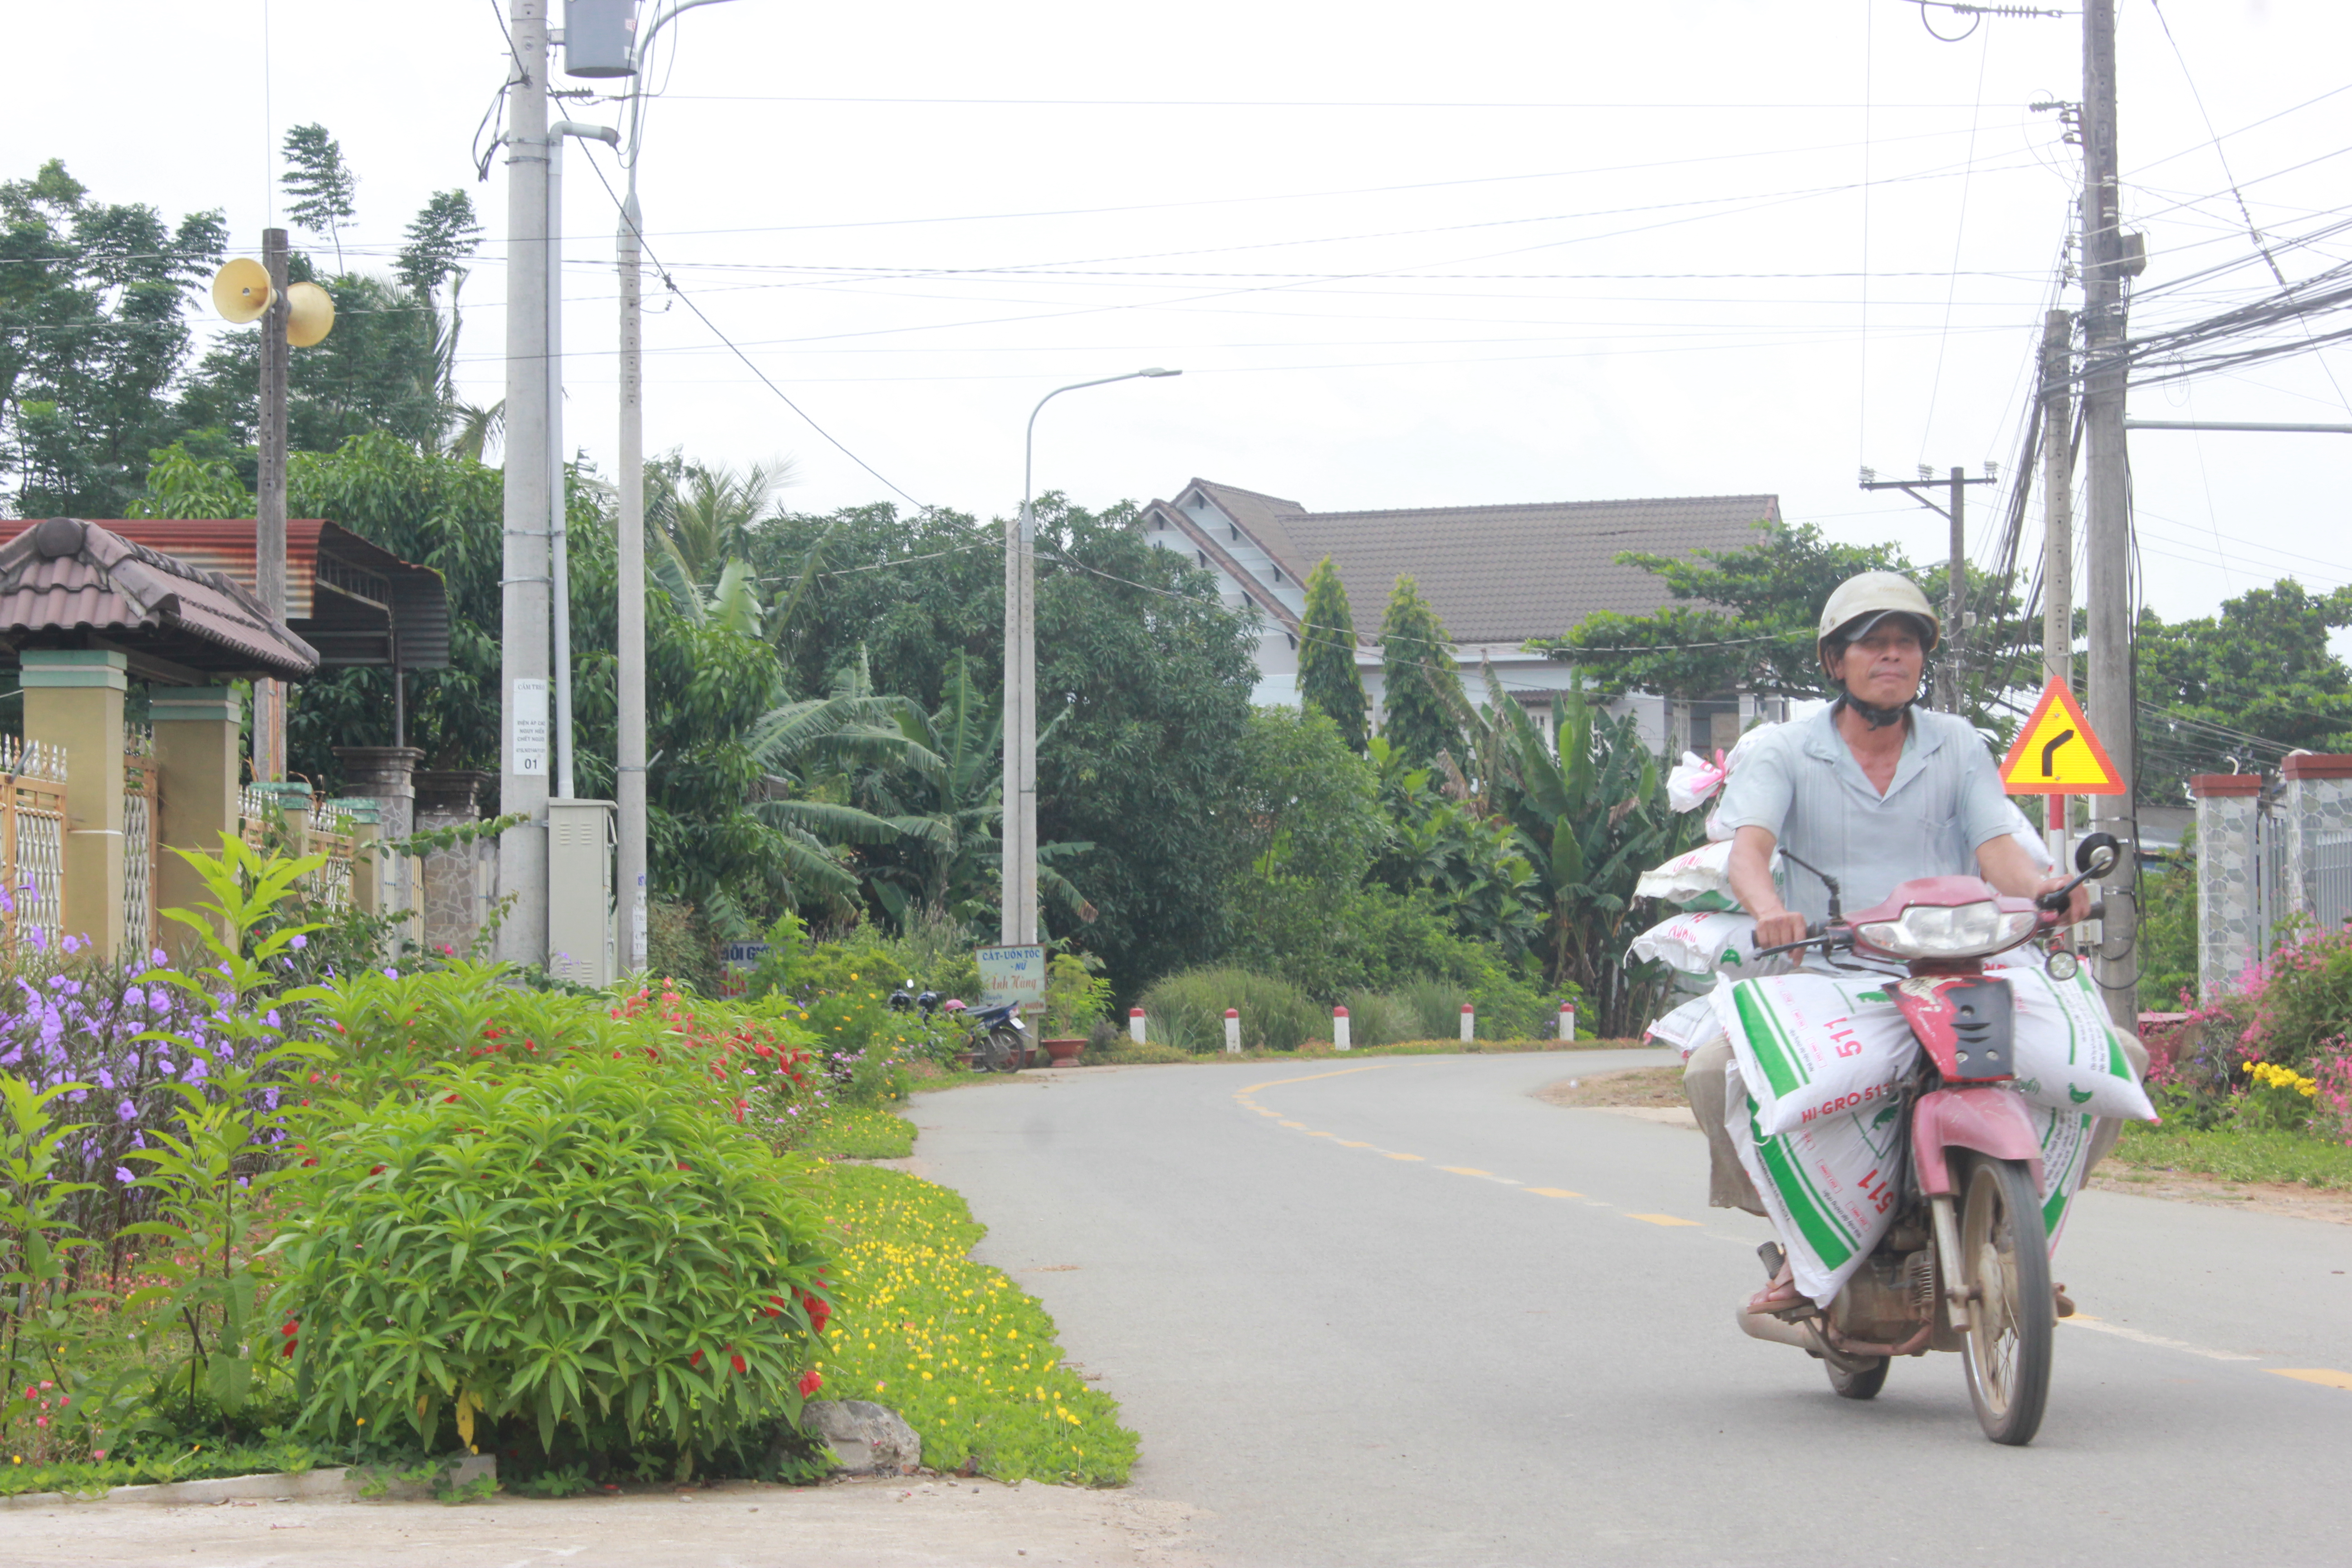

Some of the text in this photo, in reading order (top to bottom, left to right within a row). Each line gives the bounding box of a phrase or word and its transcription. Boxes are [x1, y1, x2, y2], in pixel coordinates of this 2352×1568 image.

[524, 758, 537, 769] 01
[1823, 1017, 1862, 1058] 511
[1802, 1092, 1861, 1124] HI-GRO
[1857, 1168, 1893, 1215] 511
